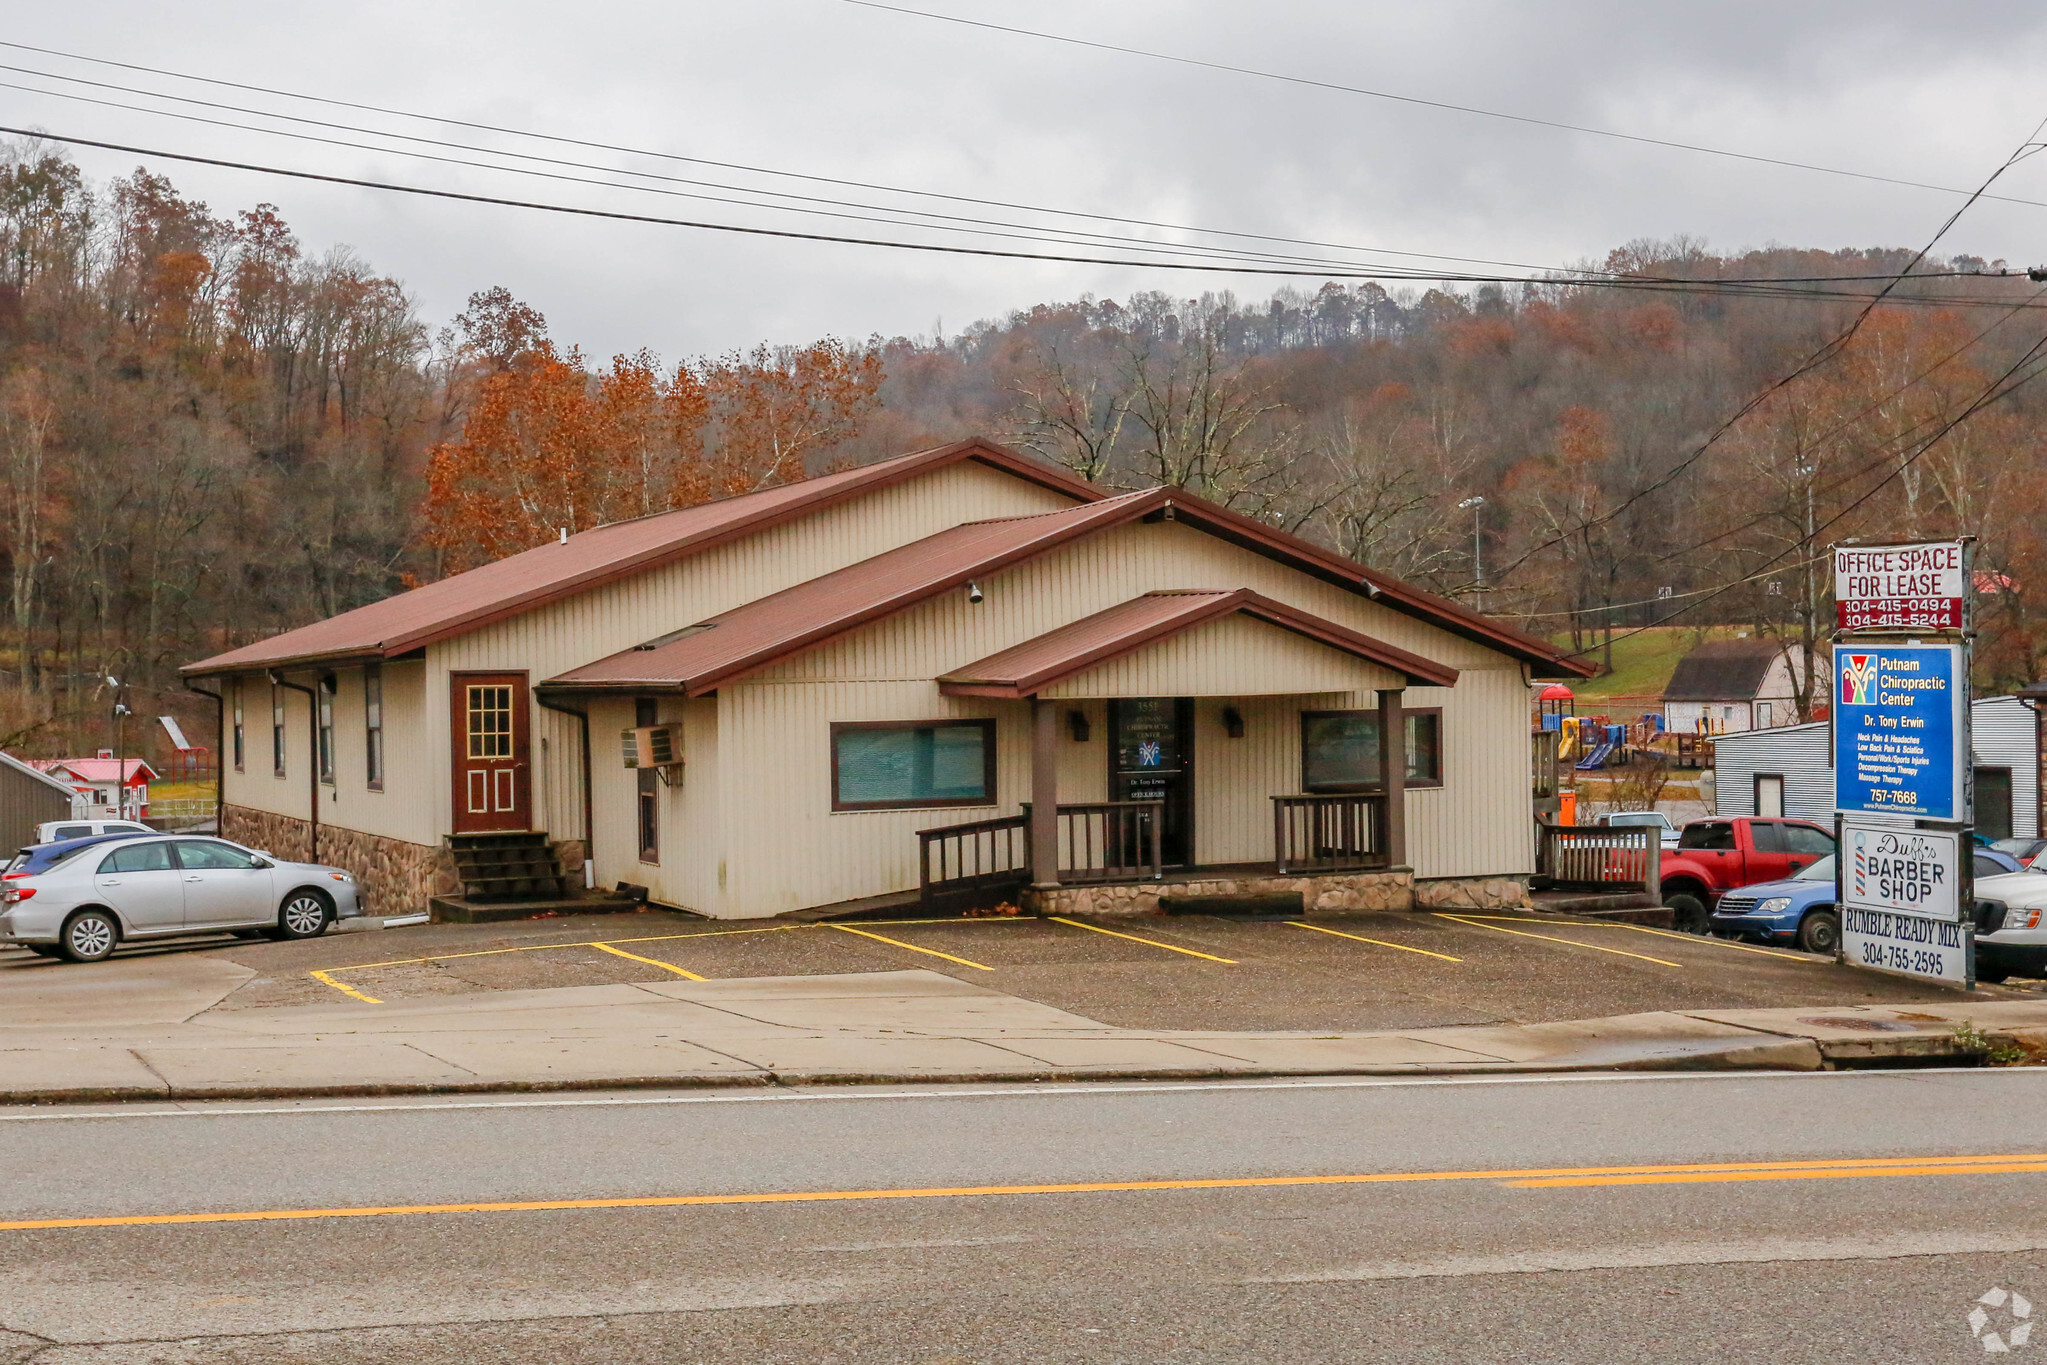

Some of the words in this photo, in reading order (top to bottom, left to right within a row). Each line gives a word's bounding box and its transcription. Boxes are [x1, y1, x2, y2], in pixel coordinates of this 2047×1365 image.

[1838, 552, 1894, 573] OFFICE
[1898, 547, 1958, 571] SPACE
[1848, 576, 1881, 597] FOR
[1887, 574, 1942, 597] LEASE
[1845, 599, 1951, 612] 304-415-0494
[1846, 613, 1951, 627] 304-415-5244
[1880, 657, 1920, 671] Putnam
[1880, 675, 1946, 691] Chiropractic
[1879, 693, 1915, 706] Center
[1864, 714, 1876, 726] Dr.
[1878, 715, 1898, 729] Tony
[1901, 715, 1925, 728] Erwin
[1857, 733, 1871, 741] Neck
[1871, 733, 1883, 742] Pain
[1884, 734, 1889, 743] &
[1890, 734, 1920, 744] Headaches
[1857, 743, 1869, 751] Low
[1869, 743, 1882, 752] Back
[1883, 744, 1895, 753] Pain
[1896, 745, 1901, 753] &
[1902, 745, 1924, 754] Sciatica
[1857, 753, 1911, 764] Personal/Work/Sports
[1911, 756, 1930, 765] Injuries
[1858, 762, 1896, 773] Decompression
[1897, 765, 1918, 776] Therapy
[1858, 772, 1881, 783] Massage
[1882, 774, 1903, 785] Therapy
[1869, 788, 1917, 804] 757-7668
[1877, 834, 1937, 861] Duff's
[1868, 856, 1945, 884] BARBER
[1879, 879, 1932, 903] SHOP
[1845, 909, 1892, 938] RUMBLE
[1895, 916, 1935, 944] READY
[1938, 922, 1961, 949] MIX
[1862, 941, 1943, 976] 304-755-2595
